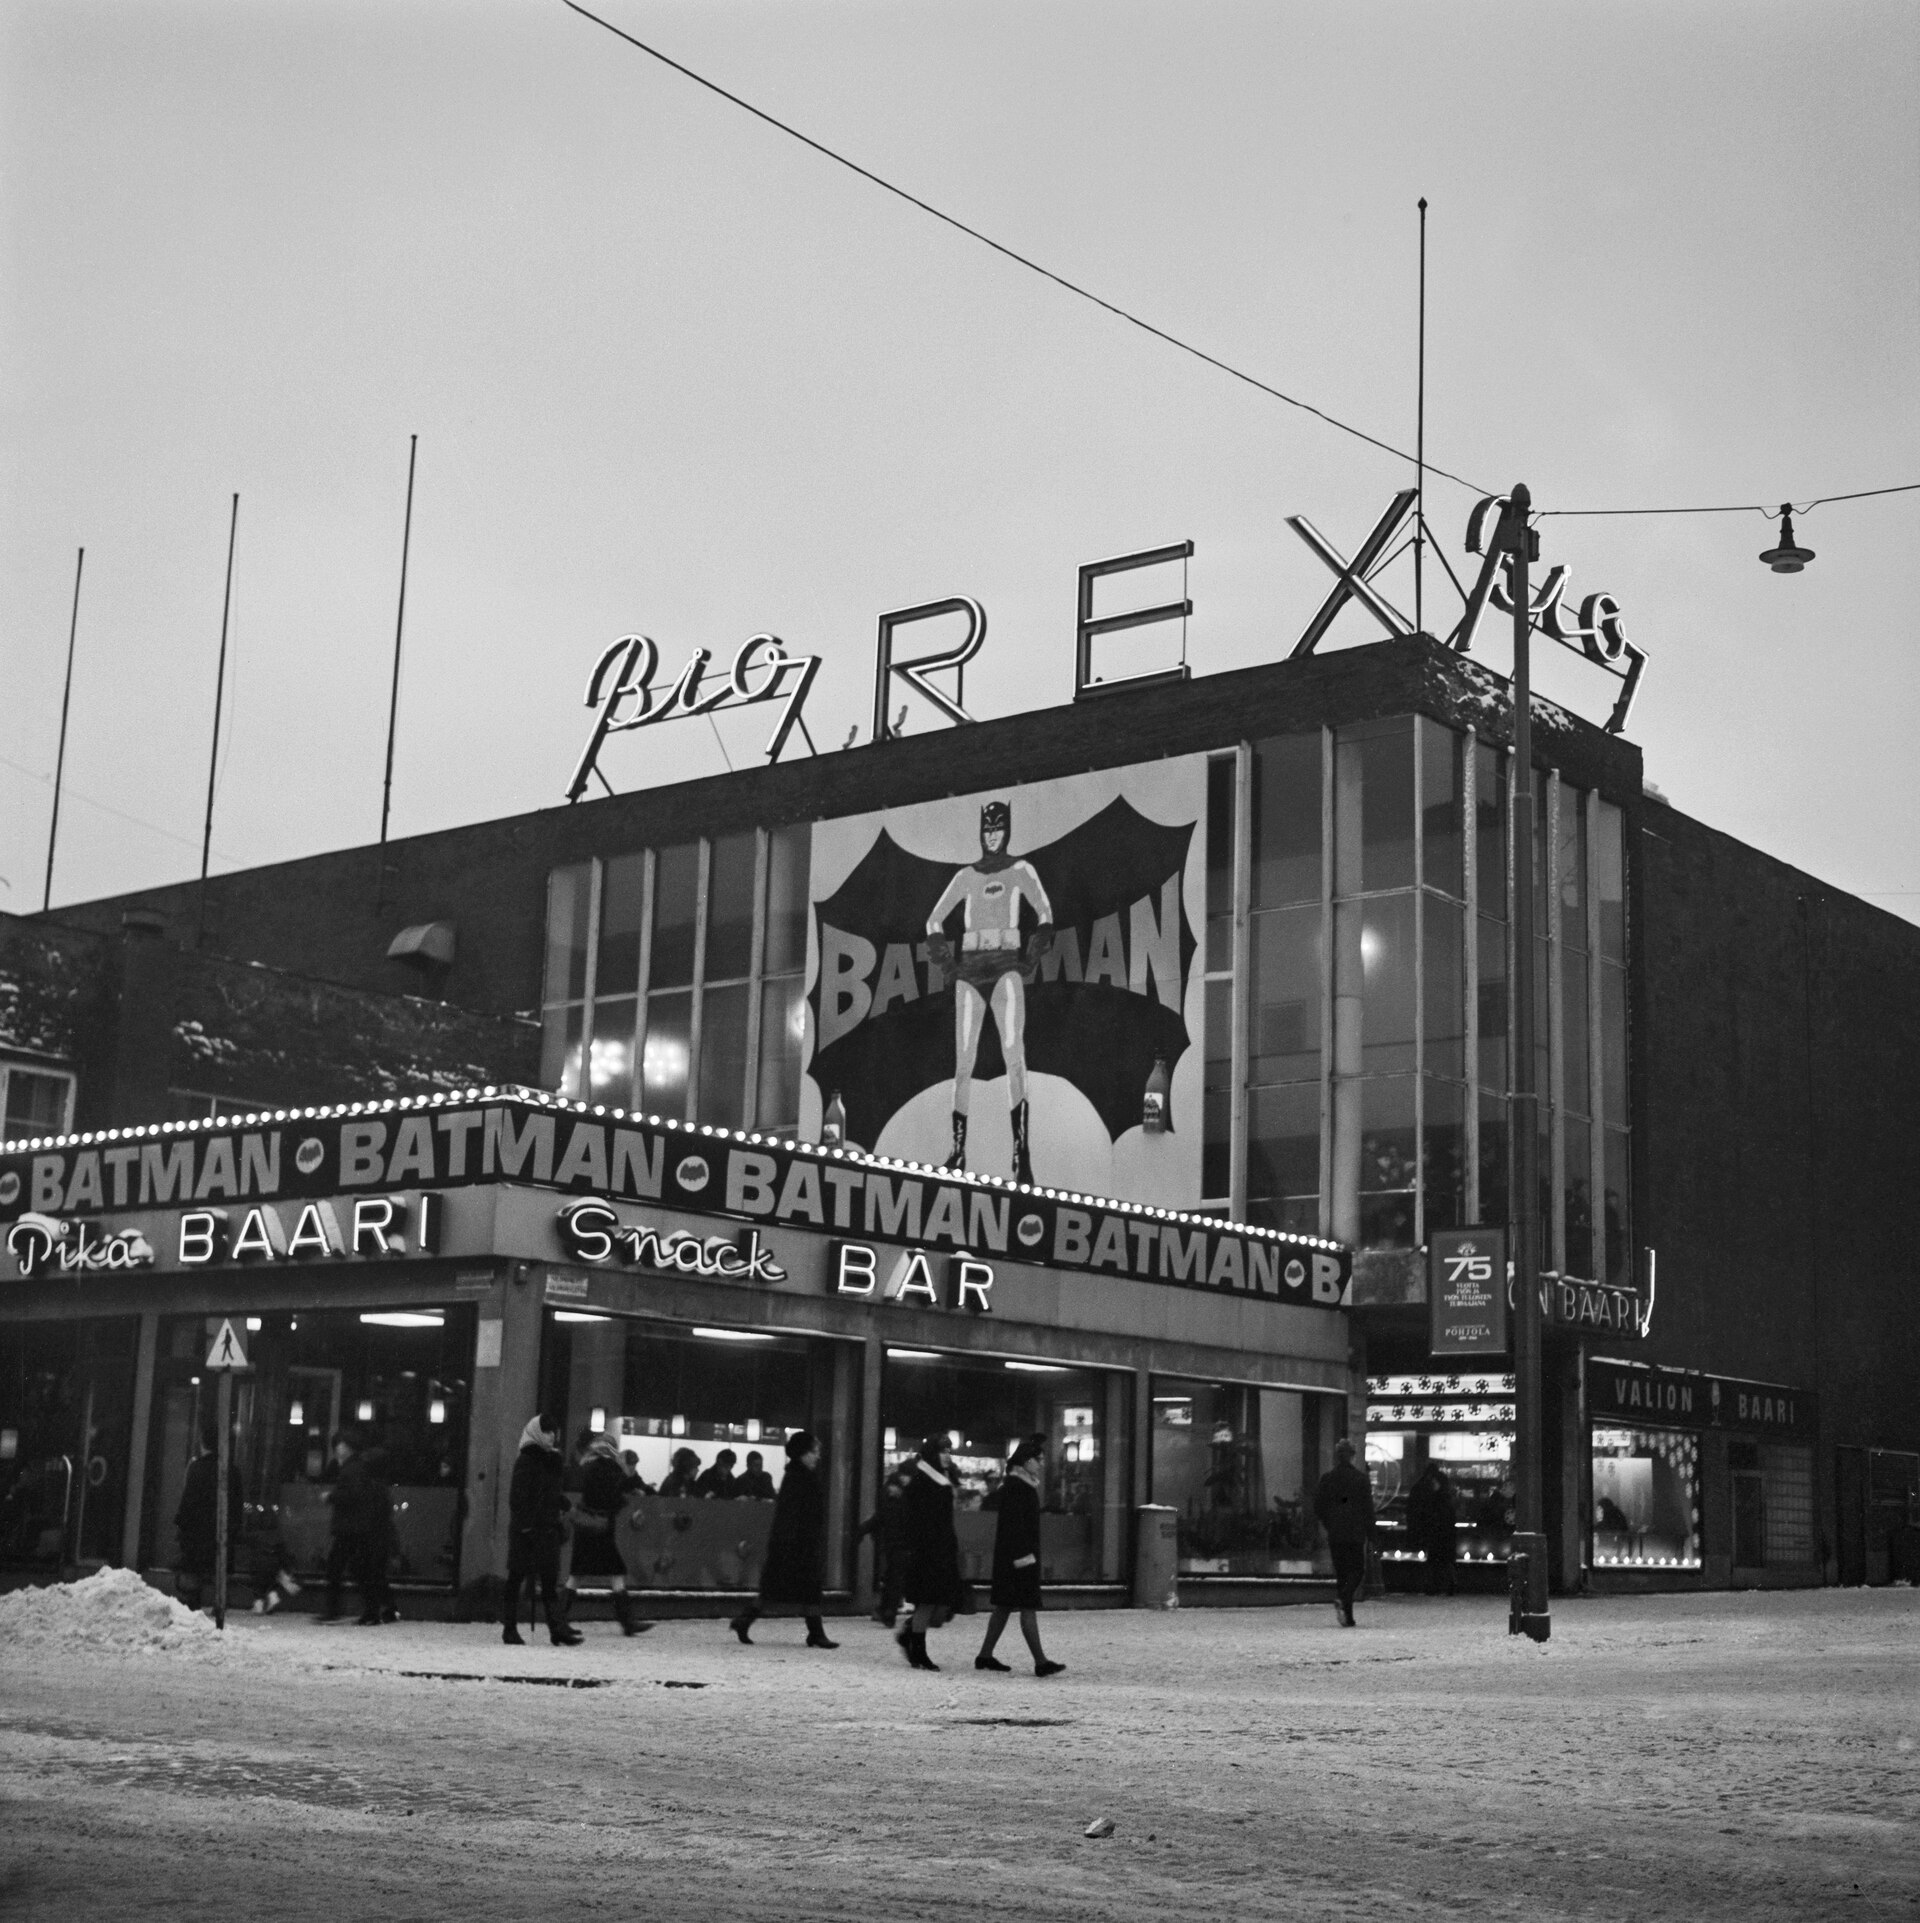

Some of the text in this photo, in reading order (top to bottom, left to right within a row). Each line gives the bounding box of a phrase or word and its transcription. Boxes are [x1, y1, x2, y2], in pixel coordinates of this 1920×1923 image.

[566, 488, 1420, 804] Bio REX
[6, 1194, 434, 1277] Pika BAARI
[31, 1131, 281, 1213] BATMAN
[339, 1107, 665, 1199] BATMAN
[725, 1148, 1011, 1252] BATMAN
[1053, 1206, 1280, 1295] BATMAN
[568, 1205, 995, 1311] Snack BAR
[1444, 1256, 1492, 1281] 75
[1445, 1328, 1491, 1336] POHJOLA
[1615, 1378, 1795, 1425] VALION BAARI
